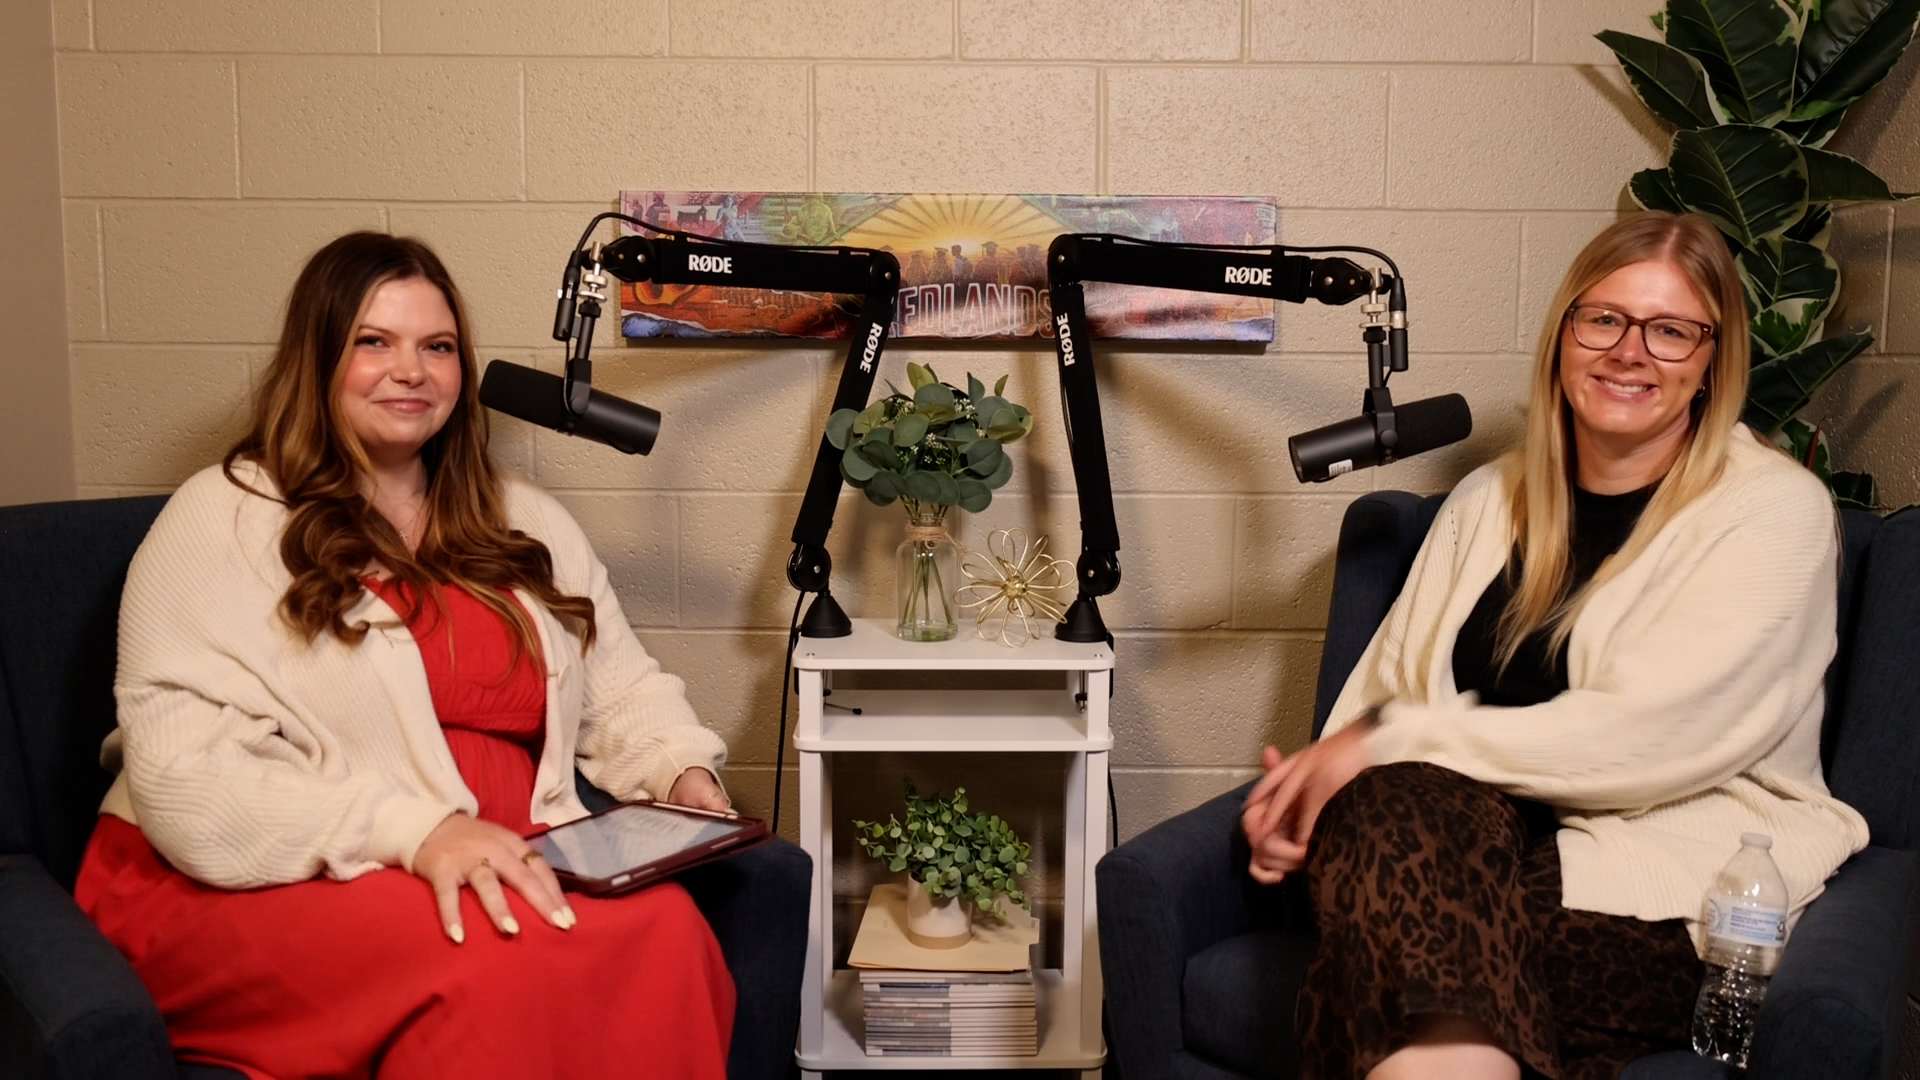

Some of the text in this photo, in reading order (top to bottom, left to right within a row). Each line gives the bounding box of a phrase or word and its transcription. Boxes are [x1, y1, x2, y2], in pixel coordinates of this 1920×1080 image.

[688, 254, 733, 274] RØDE
[1224, 266, 1273, 286] RØDE
[889, 282, 1056, 338] EDLANDS
[860, 322, 883, 373] RØDE
[1056, 312, 1076, 366] RØDE
